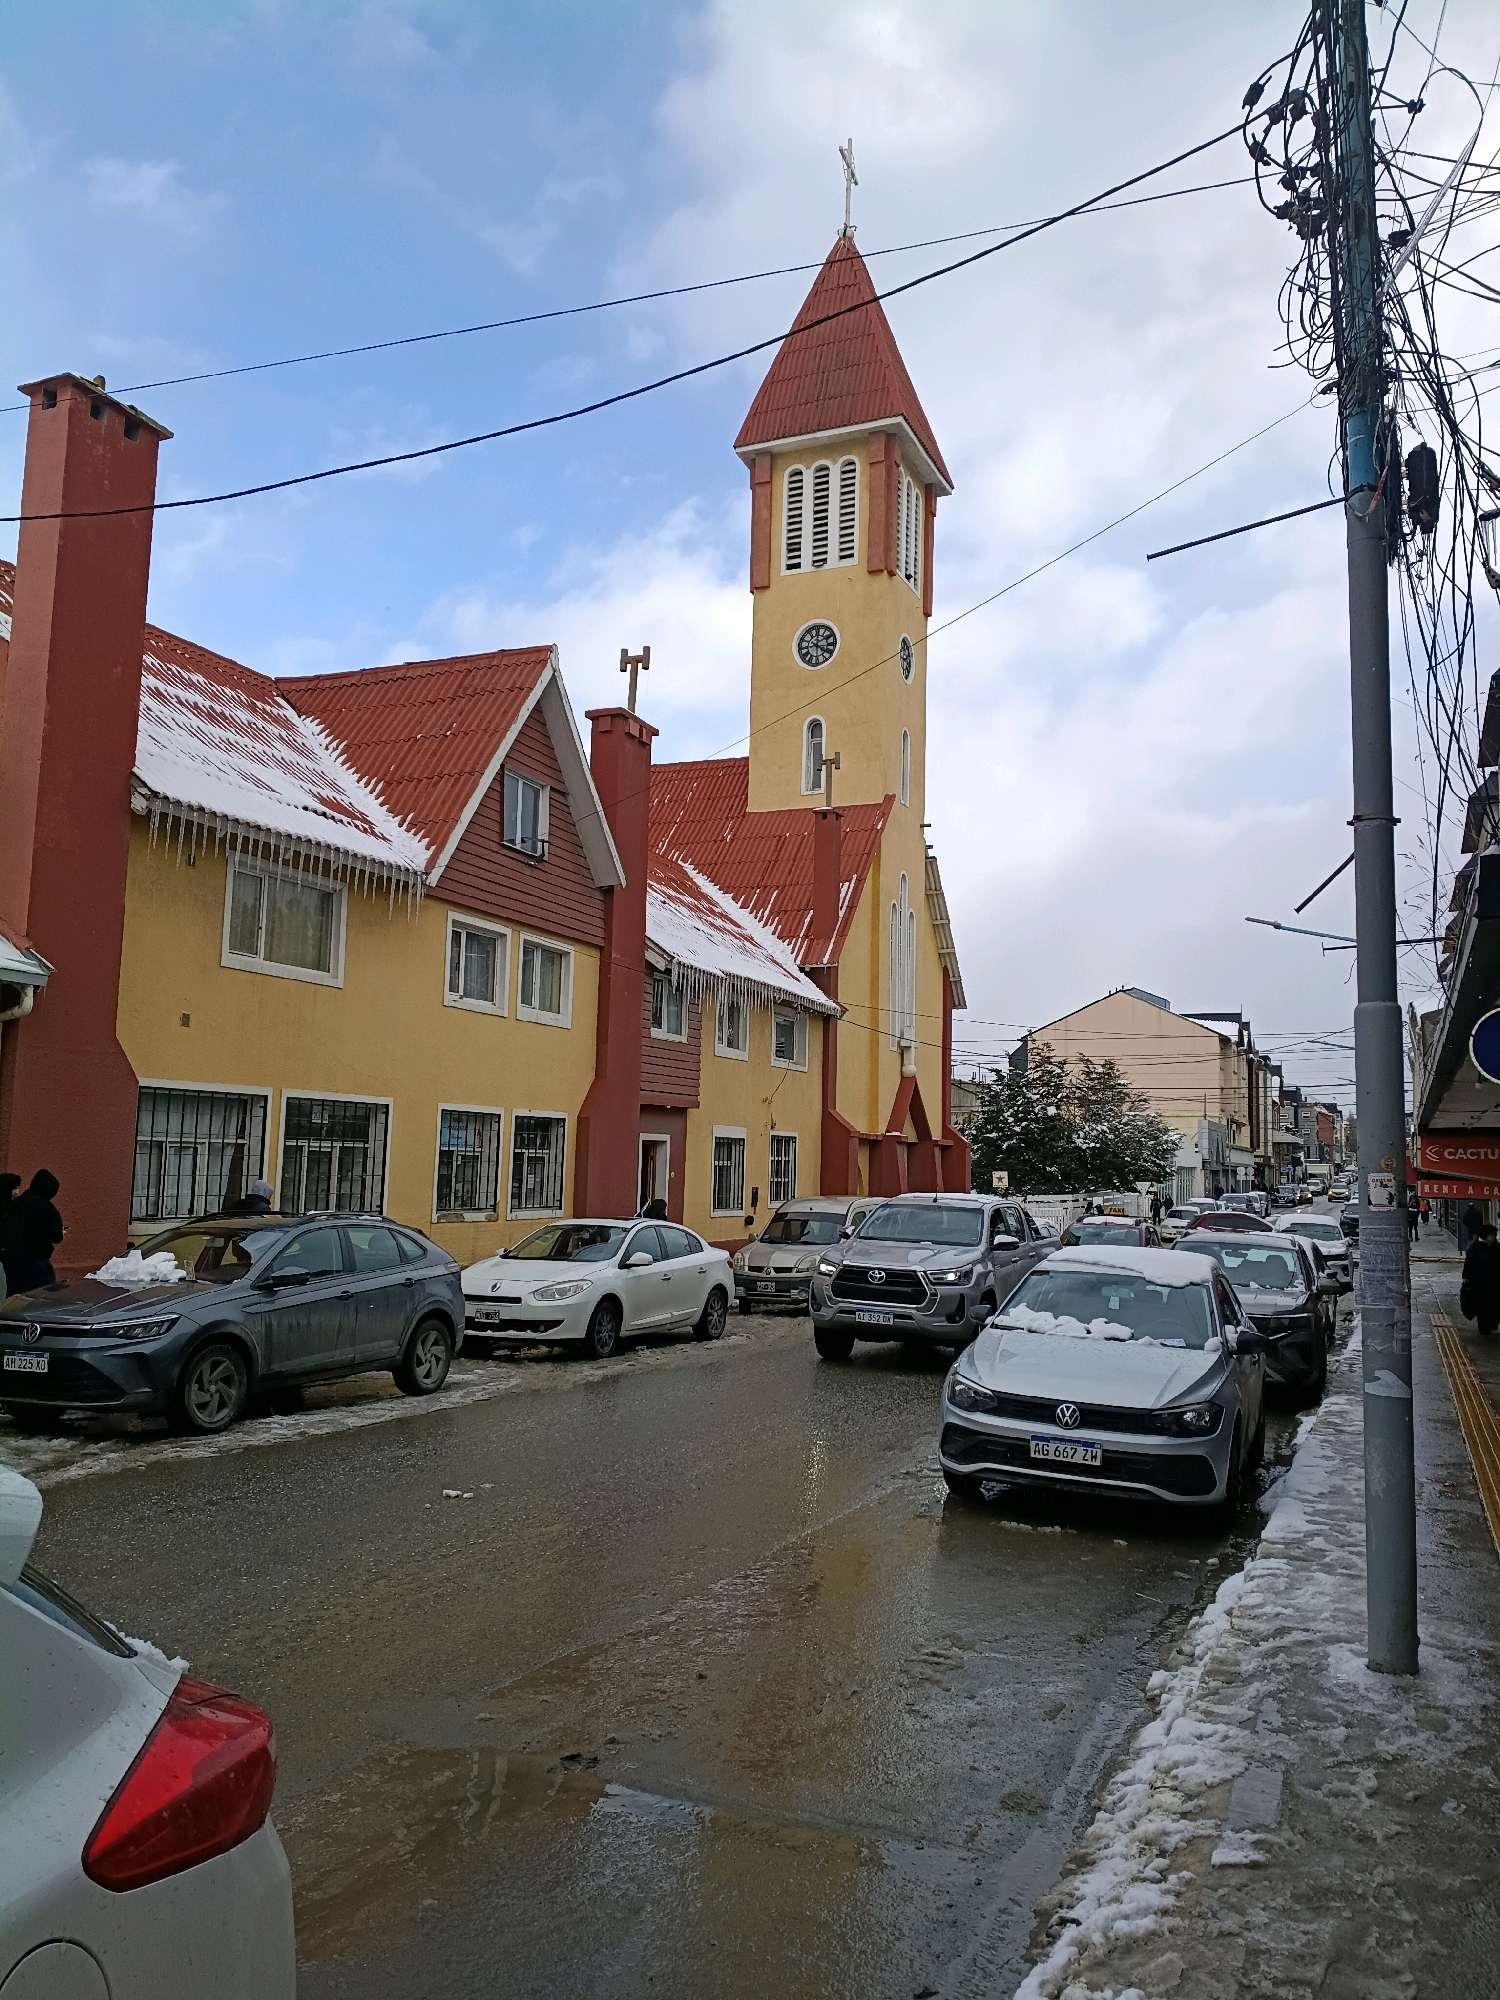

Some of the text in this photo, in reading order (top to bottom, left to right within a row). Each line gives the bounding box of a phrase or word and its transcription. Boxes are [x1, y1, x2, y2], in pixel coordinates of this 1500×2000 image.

[1443, 1148, 1500, 1160] CACTU
[1424, 1184, 1458, 1194] RENT
[1467, 1185, 1474, 1195] A
[1108, 1206, 1126, 1214] TAXI
[867, 1313, 881, 1323] 352
[5, 1356, 16, 1369] AH
[18, 1358, 34, 1370] 225
[1033, 1442, 1050, 1457] AG
[1053, 1445, 1078, 1460] 667
